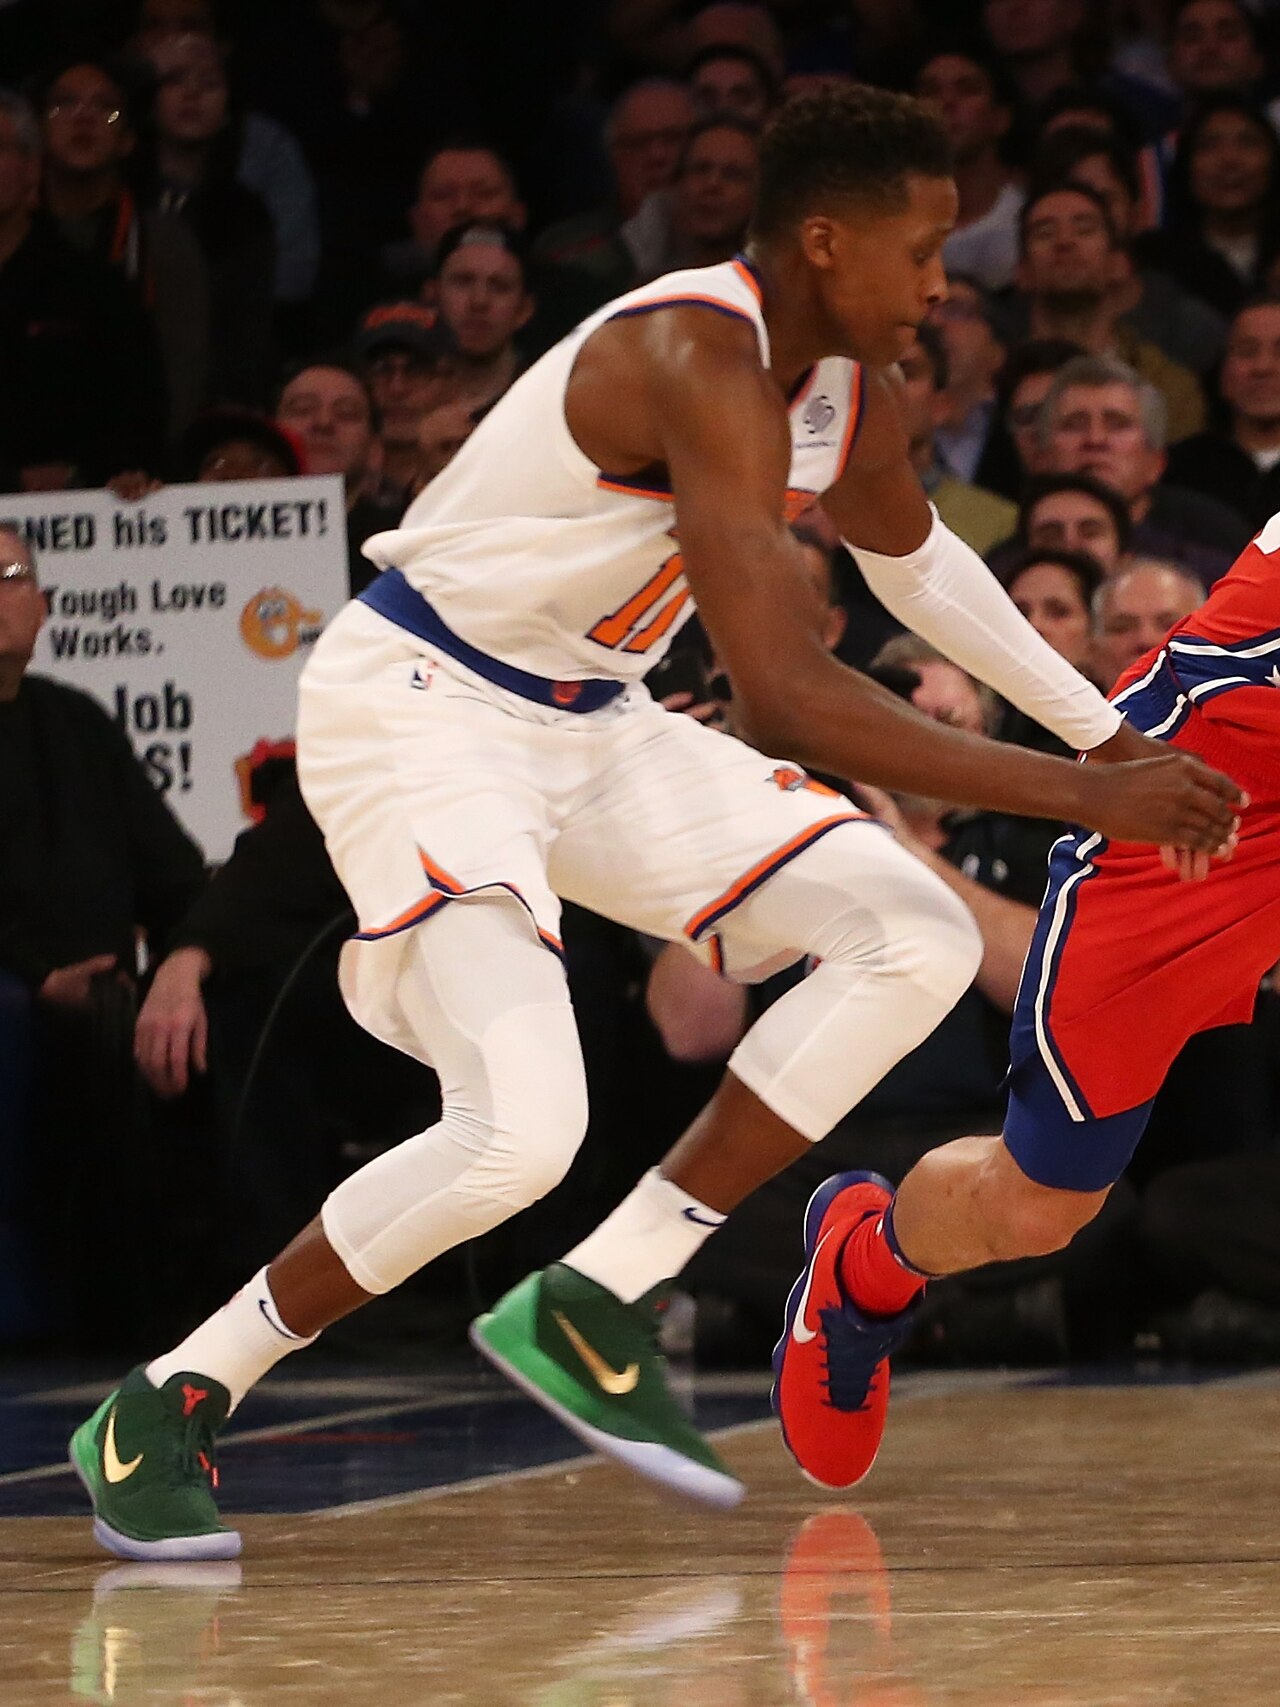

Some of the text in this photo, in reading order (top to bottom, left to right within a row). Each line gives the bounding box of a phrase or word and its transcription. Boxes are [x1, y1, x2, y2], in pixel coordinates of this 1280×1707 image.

[114, 509, 167, 549] his
[184, 499, 328, 543] TICKET!
[43, 580, 226, 620] Tough Love
